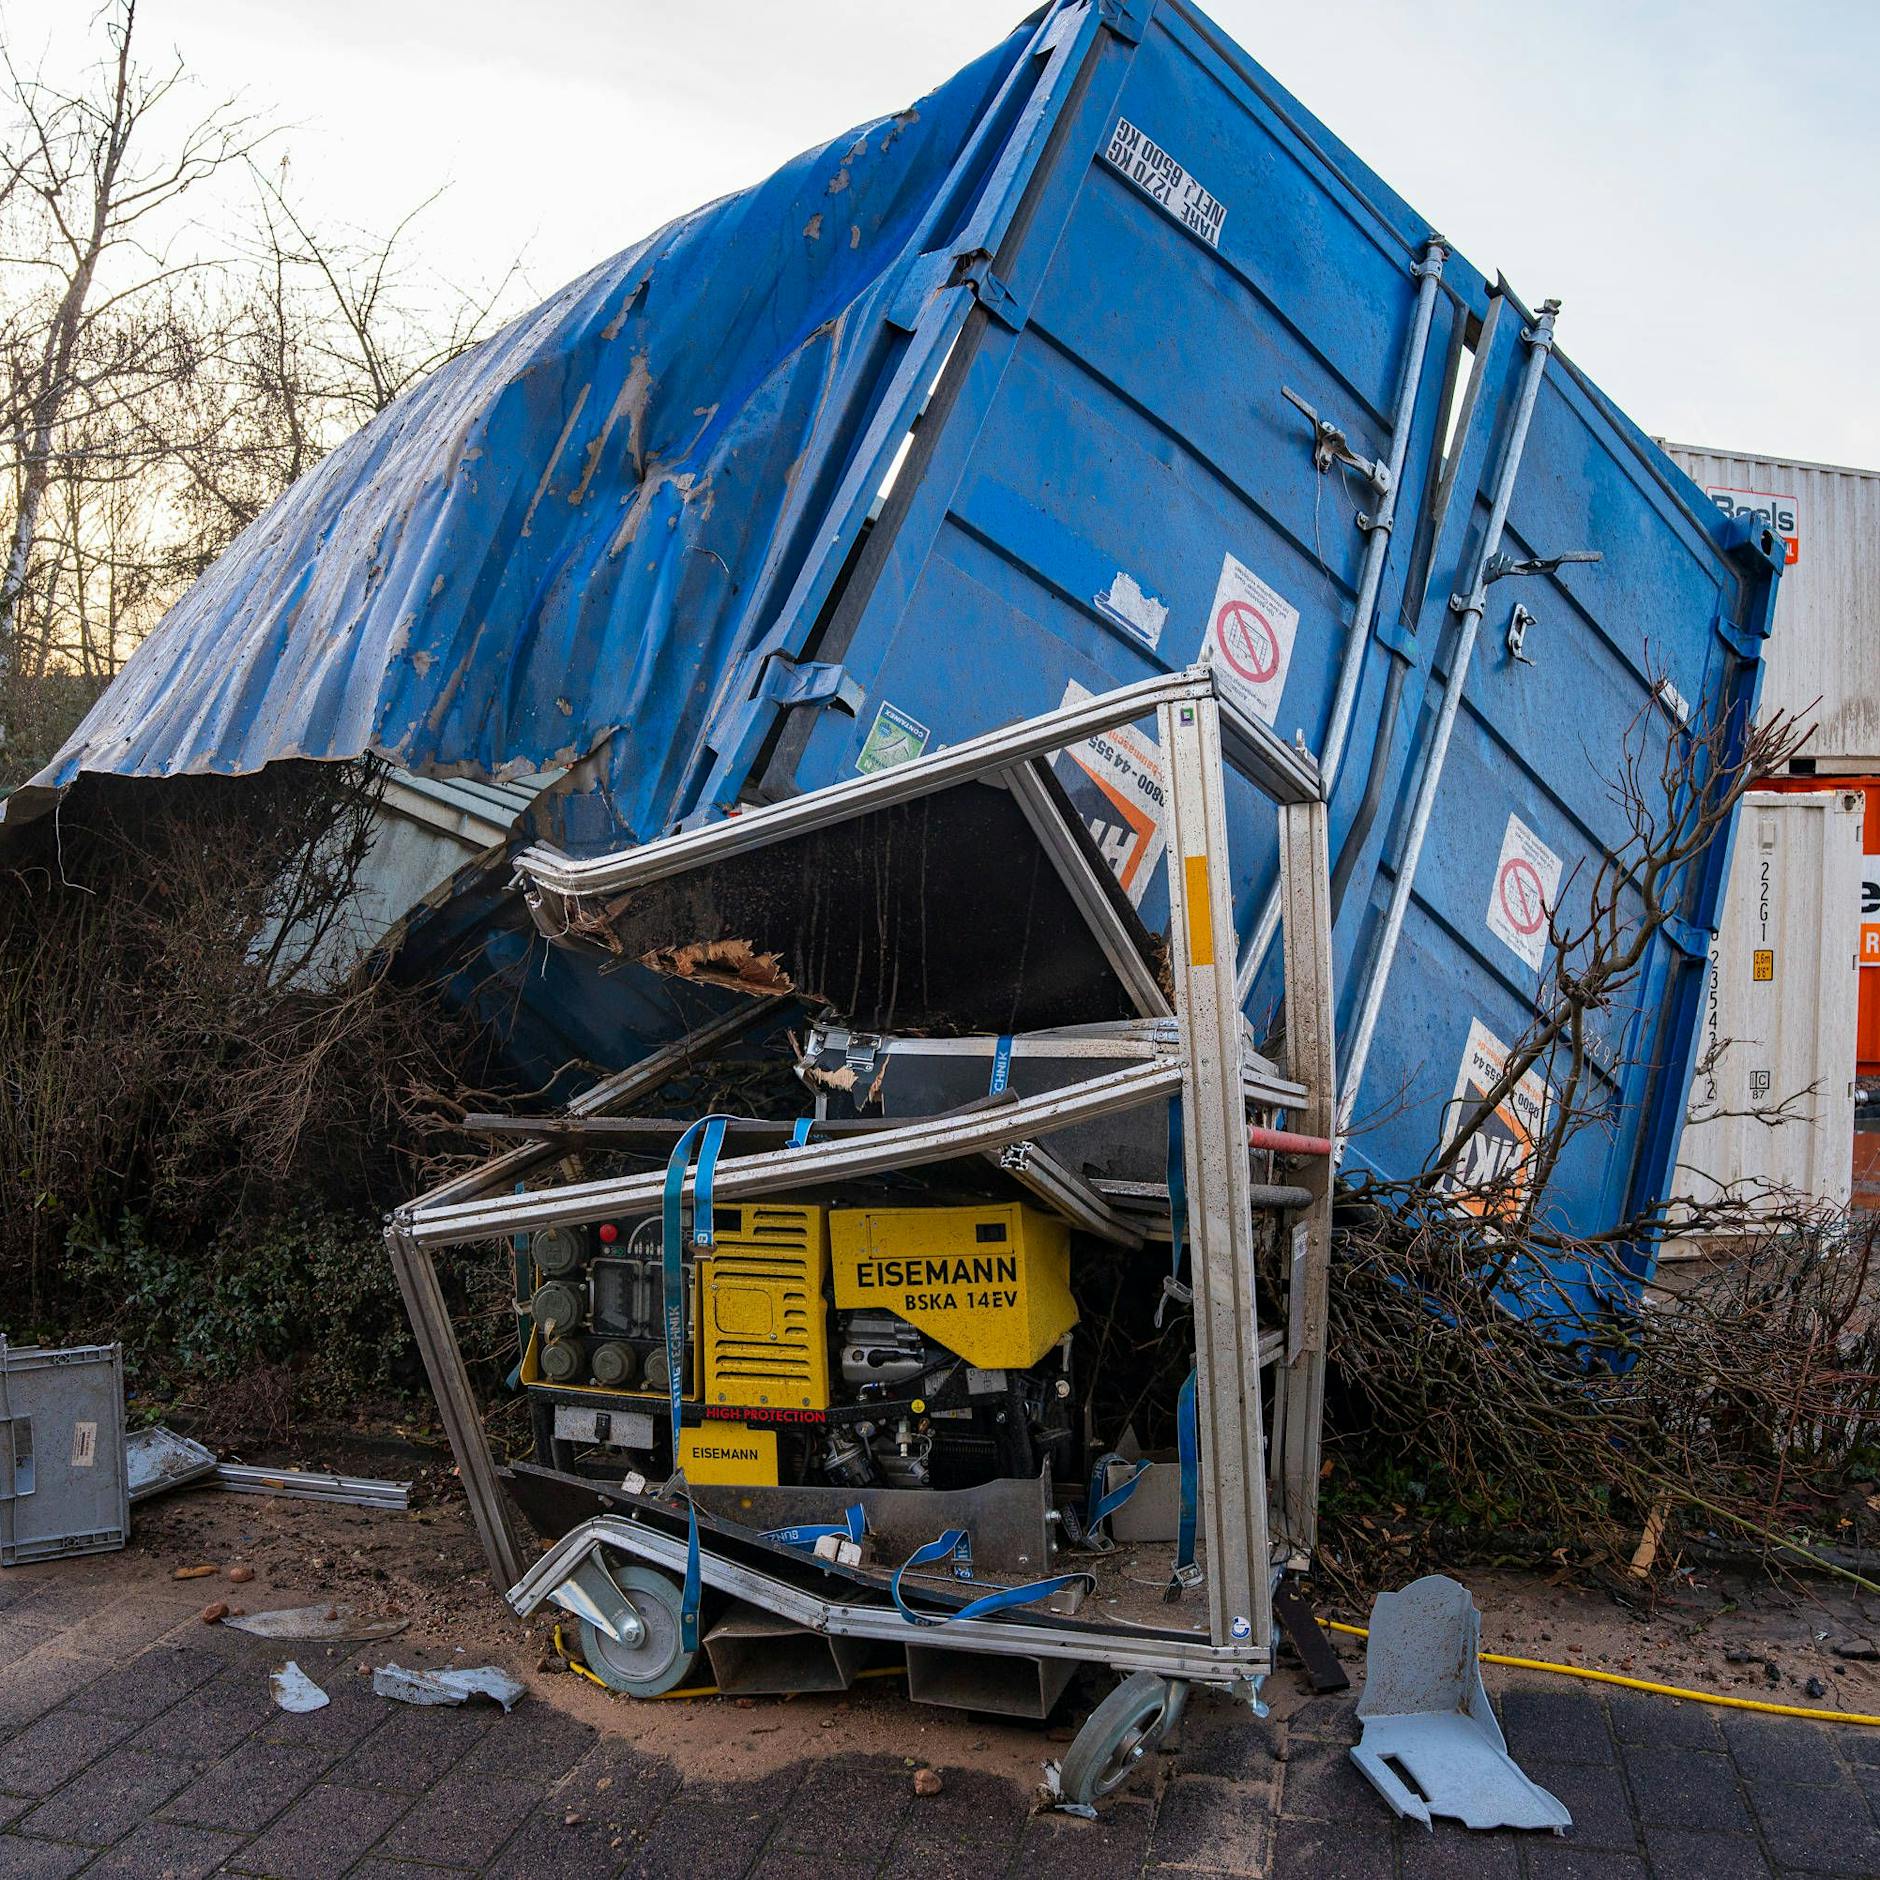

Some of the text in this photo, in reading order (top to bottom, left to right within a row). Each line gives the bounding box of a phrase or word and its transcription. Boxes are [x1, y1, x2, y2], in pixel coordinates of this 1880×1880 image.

[1117, 120, 1141, 151] KG
[1142, 140, 1183, 188] 6500
[1108, 140, 1216, 246] TARE 1270 KG
[885, 709, 924, 738] CONTAINEX
[1114, 753, 1131, 774] 44
[1760, 862, 1770, 942] 22G1
[993, 1051, 1008, 1094] CHNIK
[857, 1257, 1017, 1288] EISEMANN
[905, 1291, 1017, 1310] BSKA 14EV
[706, 1408, 826, 1423] HIGH PROTECTION
[692, 1447, 758, 1460] EISEMANN
